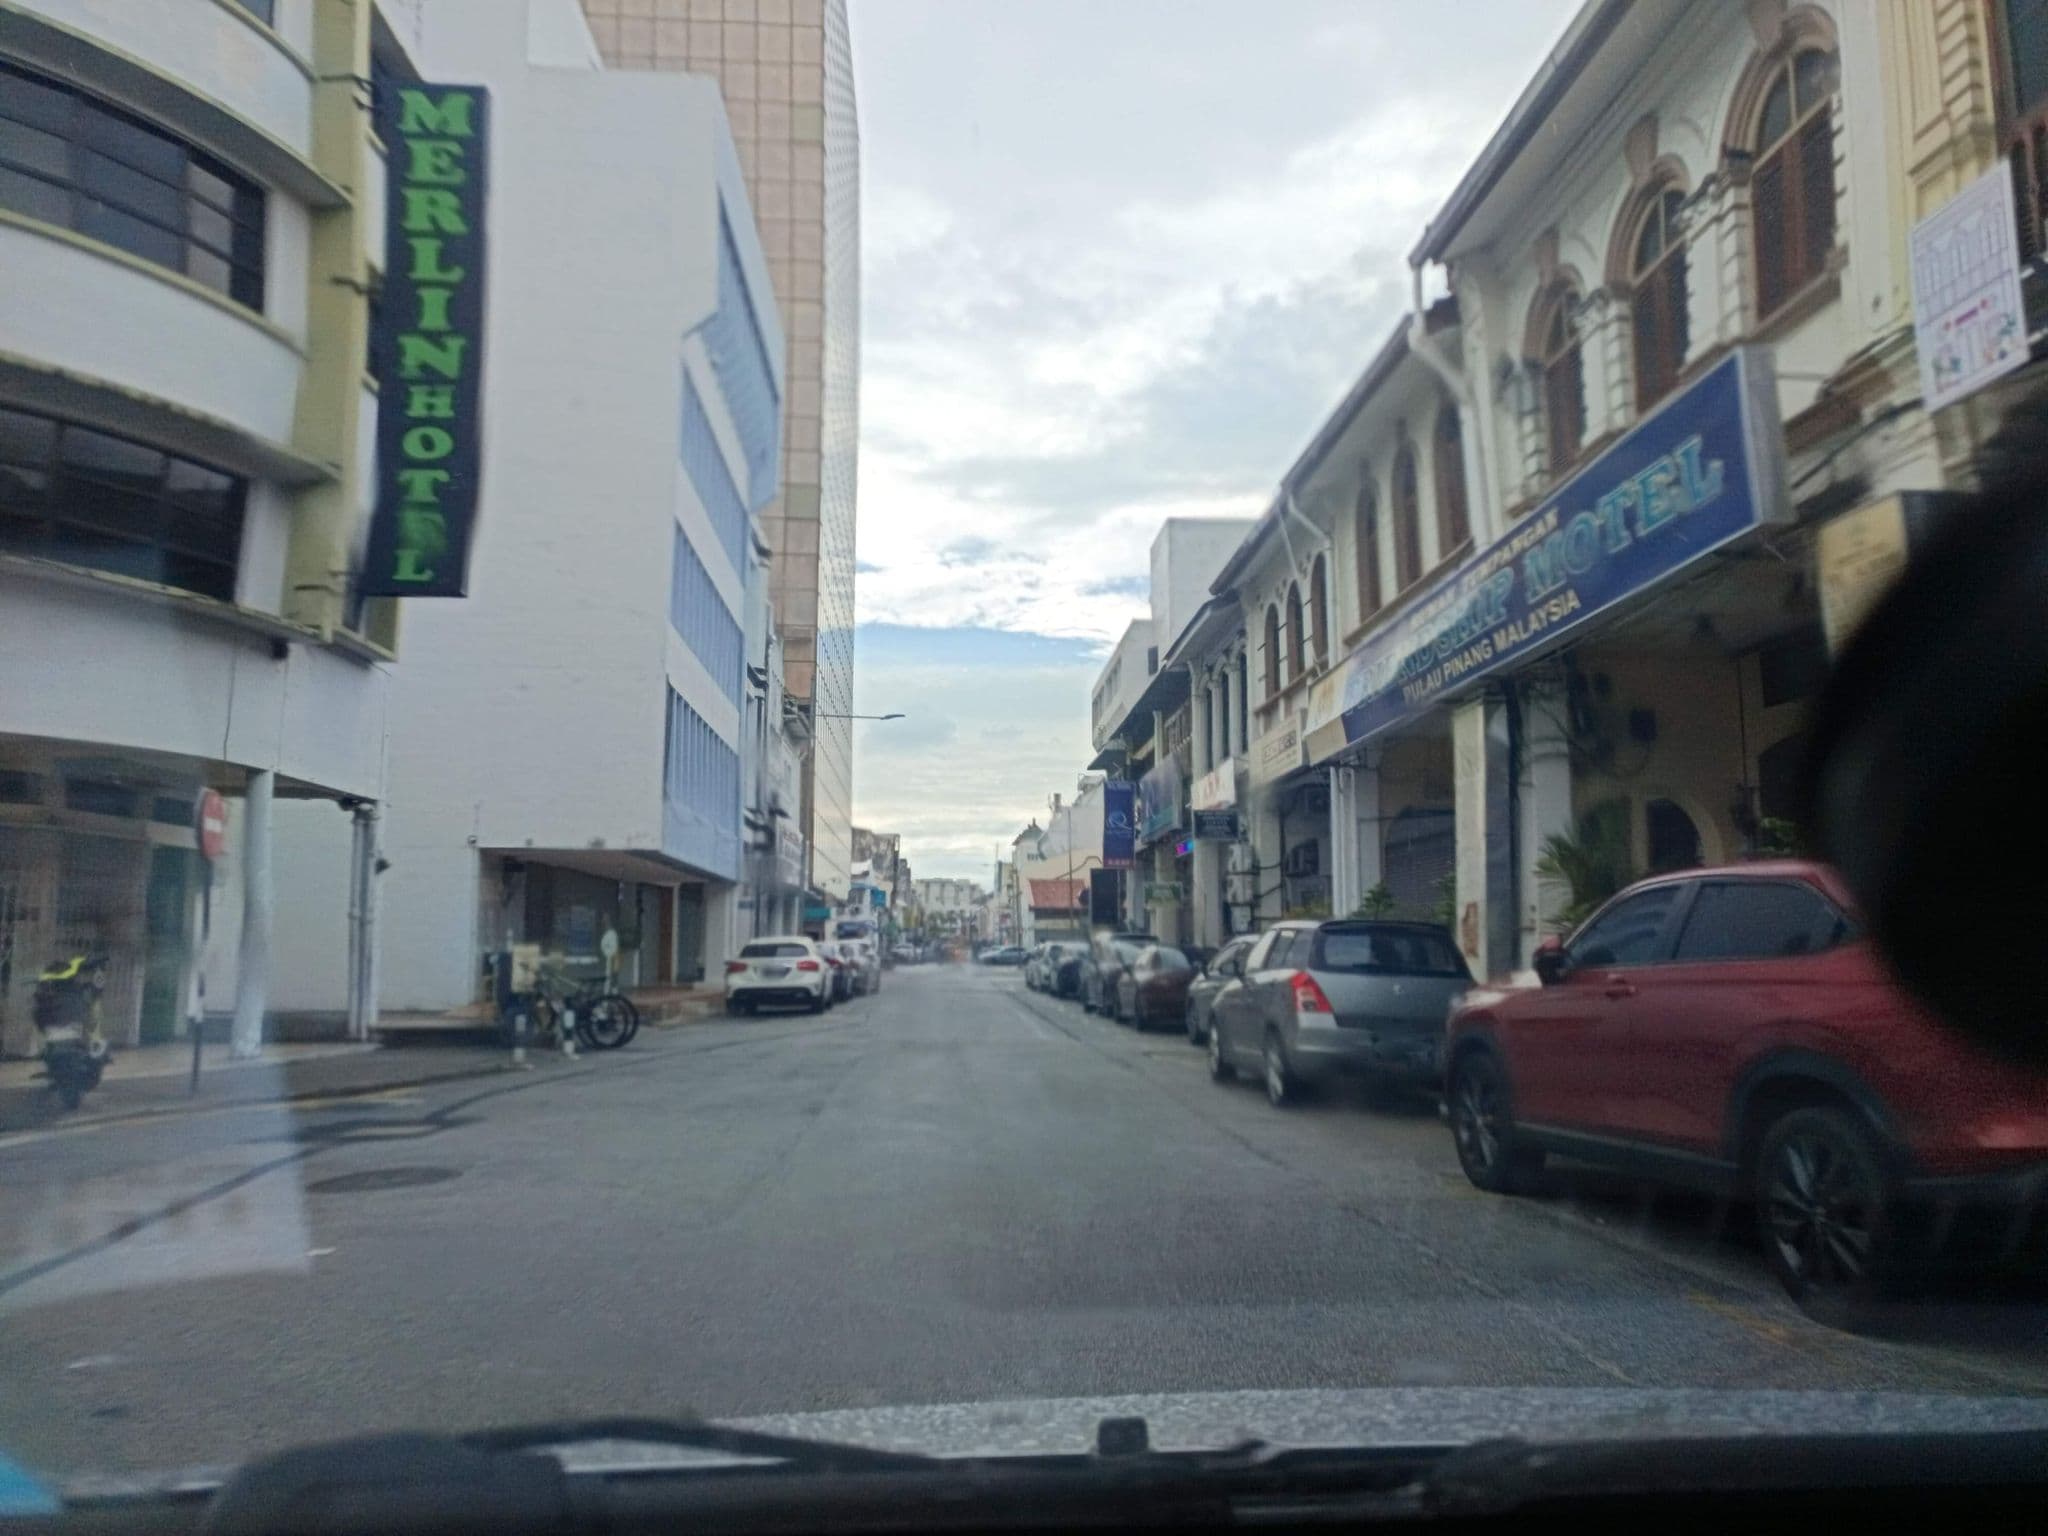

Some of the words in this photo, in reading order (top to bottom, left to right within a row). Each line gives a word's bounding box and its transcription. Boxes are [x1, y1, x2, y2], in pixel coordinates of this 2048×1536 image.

[398, 89, 473, 379] MERLIN
[1524, 433, 1724, 605] MOTEL
[1402, 669, 1443, 704] PULAU
[1443, 637, 1494, 686] PINANG
[1492, 587, 1582, 652] MALAYSIA
